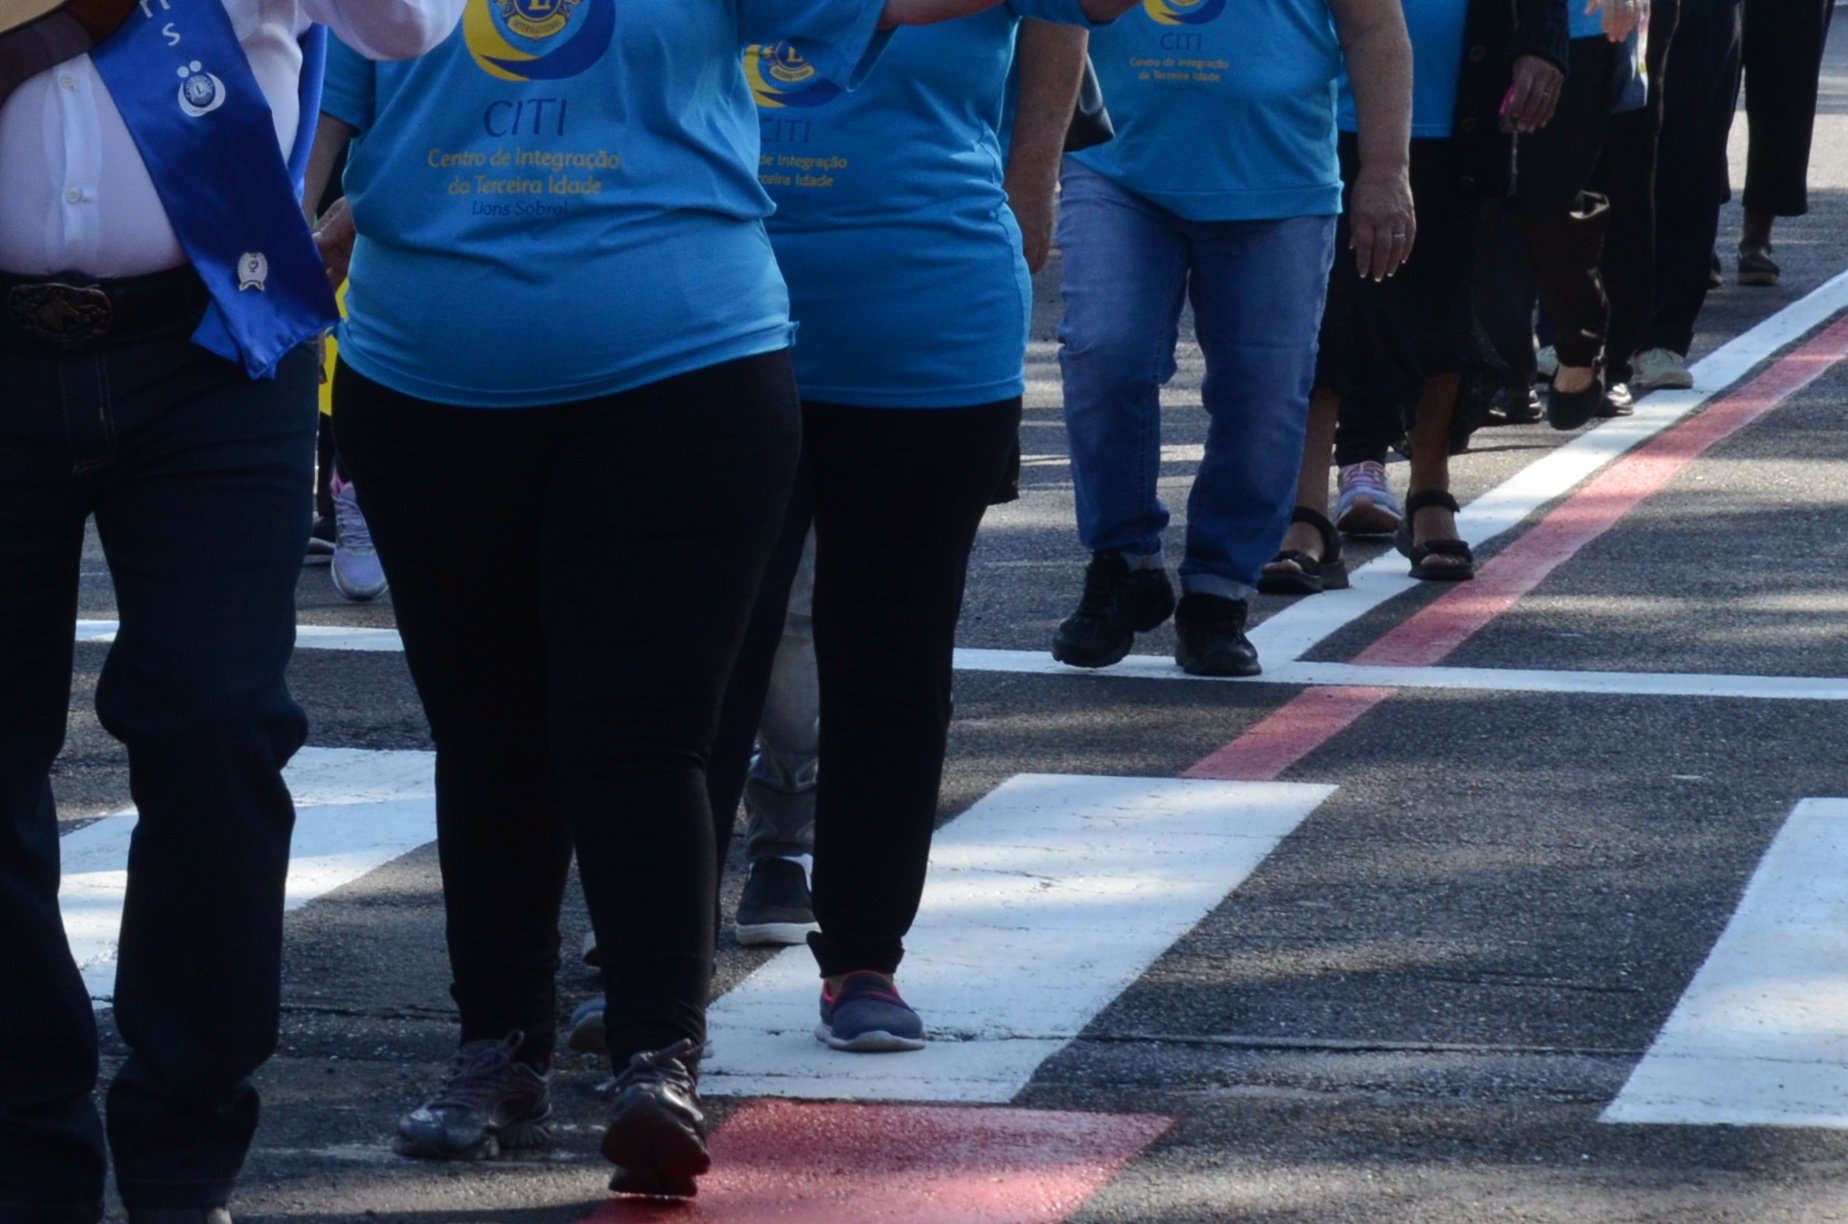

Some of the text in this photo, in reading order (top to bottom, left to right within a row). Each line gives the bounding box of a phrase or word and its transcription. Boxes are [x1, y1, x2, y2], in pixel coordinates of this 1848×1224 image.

[1160, 32, 1202, 51] CITI
[483, 98, 568, 137] CITI
[428, 147, 621, 172] Centro de Integração
[777, 154, 848, 172] Integração
[448, 175, 602, 195] da Terceira Idade
[795, 174, 834, 187] Idade
[472, 200, 569, 217] Lions Sobral
